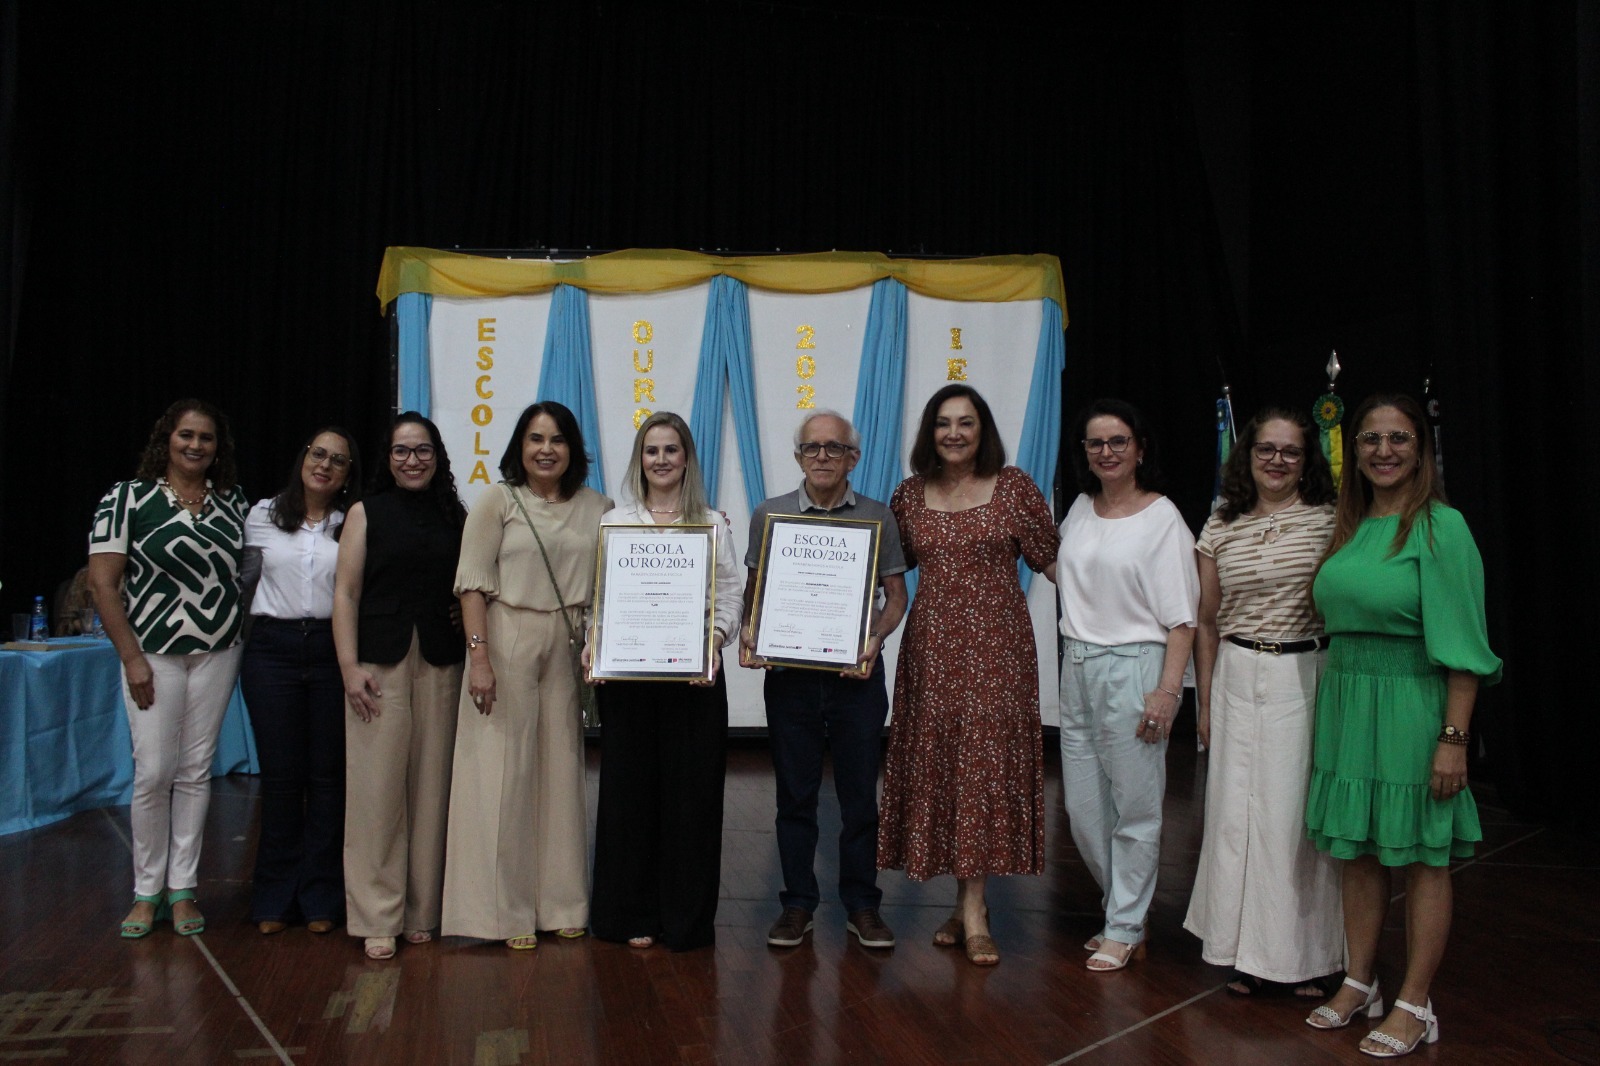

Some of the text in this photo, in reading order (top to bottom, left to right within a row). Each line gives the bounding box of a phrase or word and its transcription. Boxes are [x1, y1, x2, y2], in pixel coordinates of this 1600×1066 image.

[796, 324, 816, 409] 202
[632, 320, 656, 431] OURO
[468, 318, 496, 484] ESCOLA
[794, 534, 847, 548] ESCOLA
[630, 544, 684, 554] ESCOLA
[781, 547, 857, 562] OURO/2024
[618, 557, 695, 569] OURO/2024
